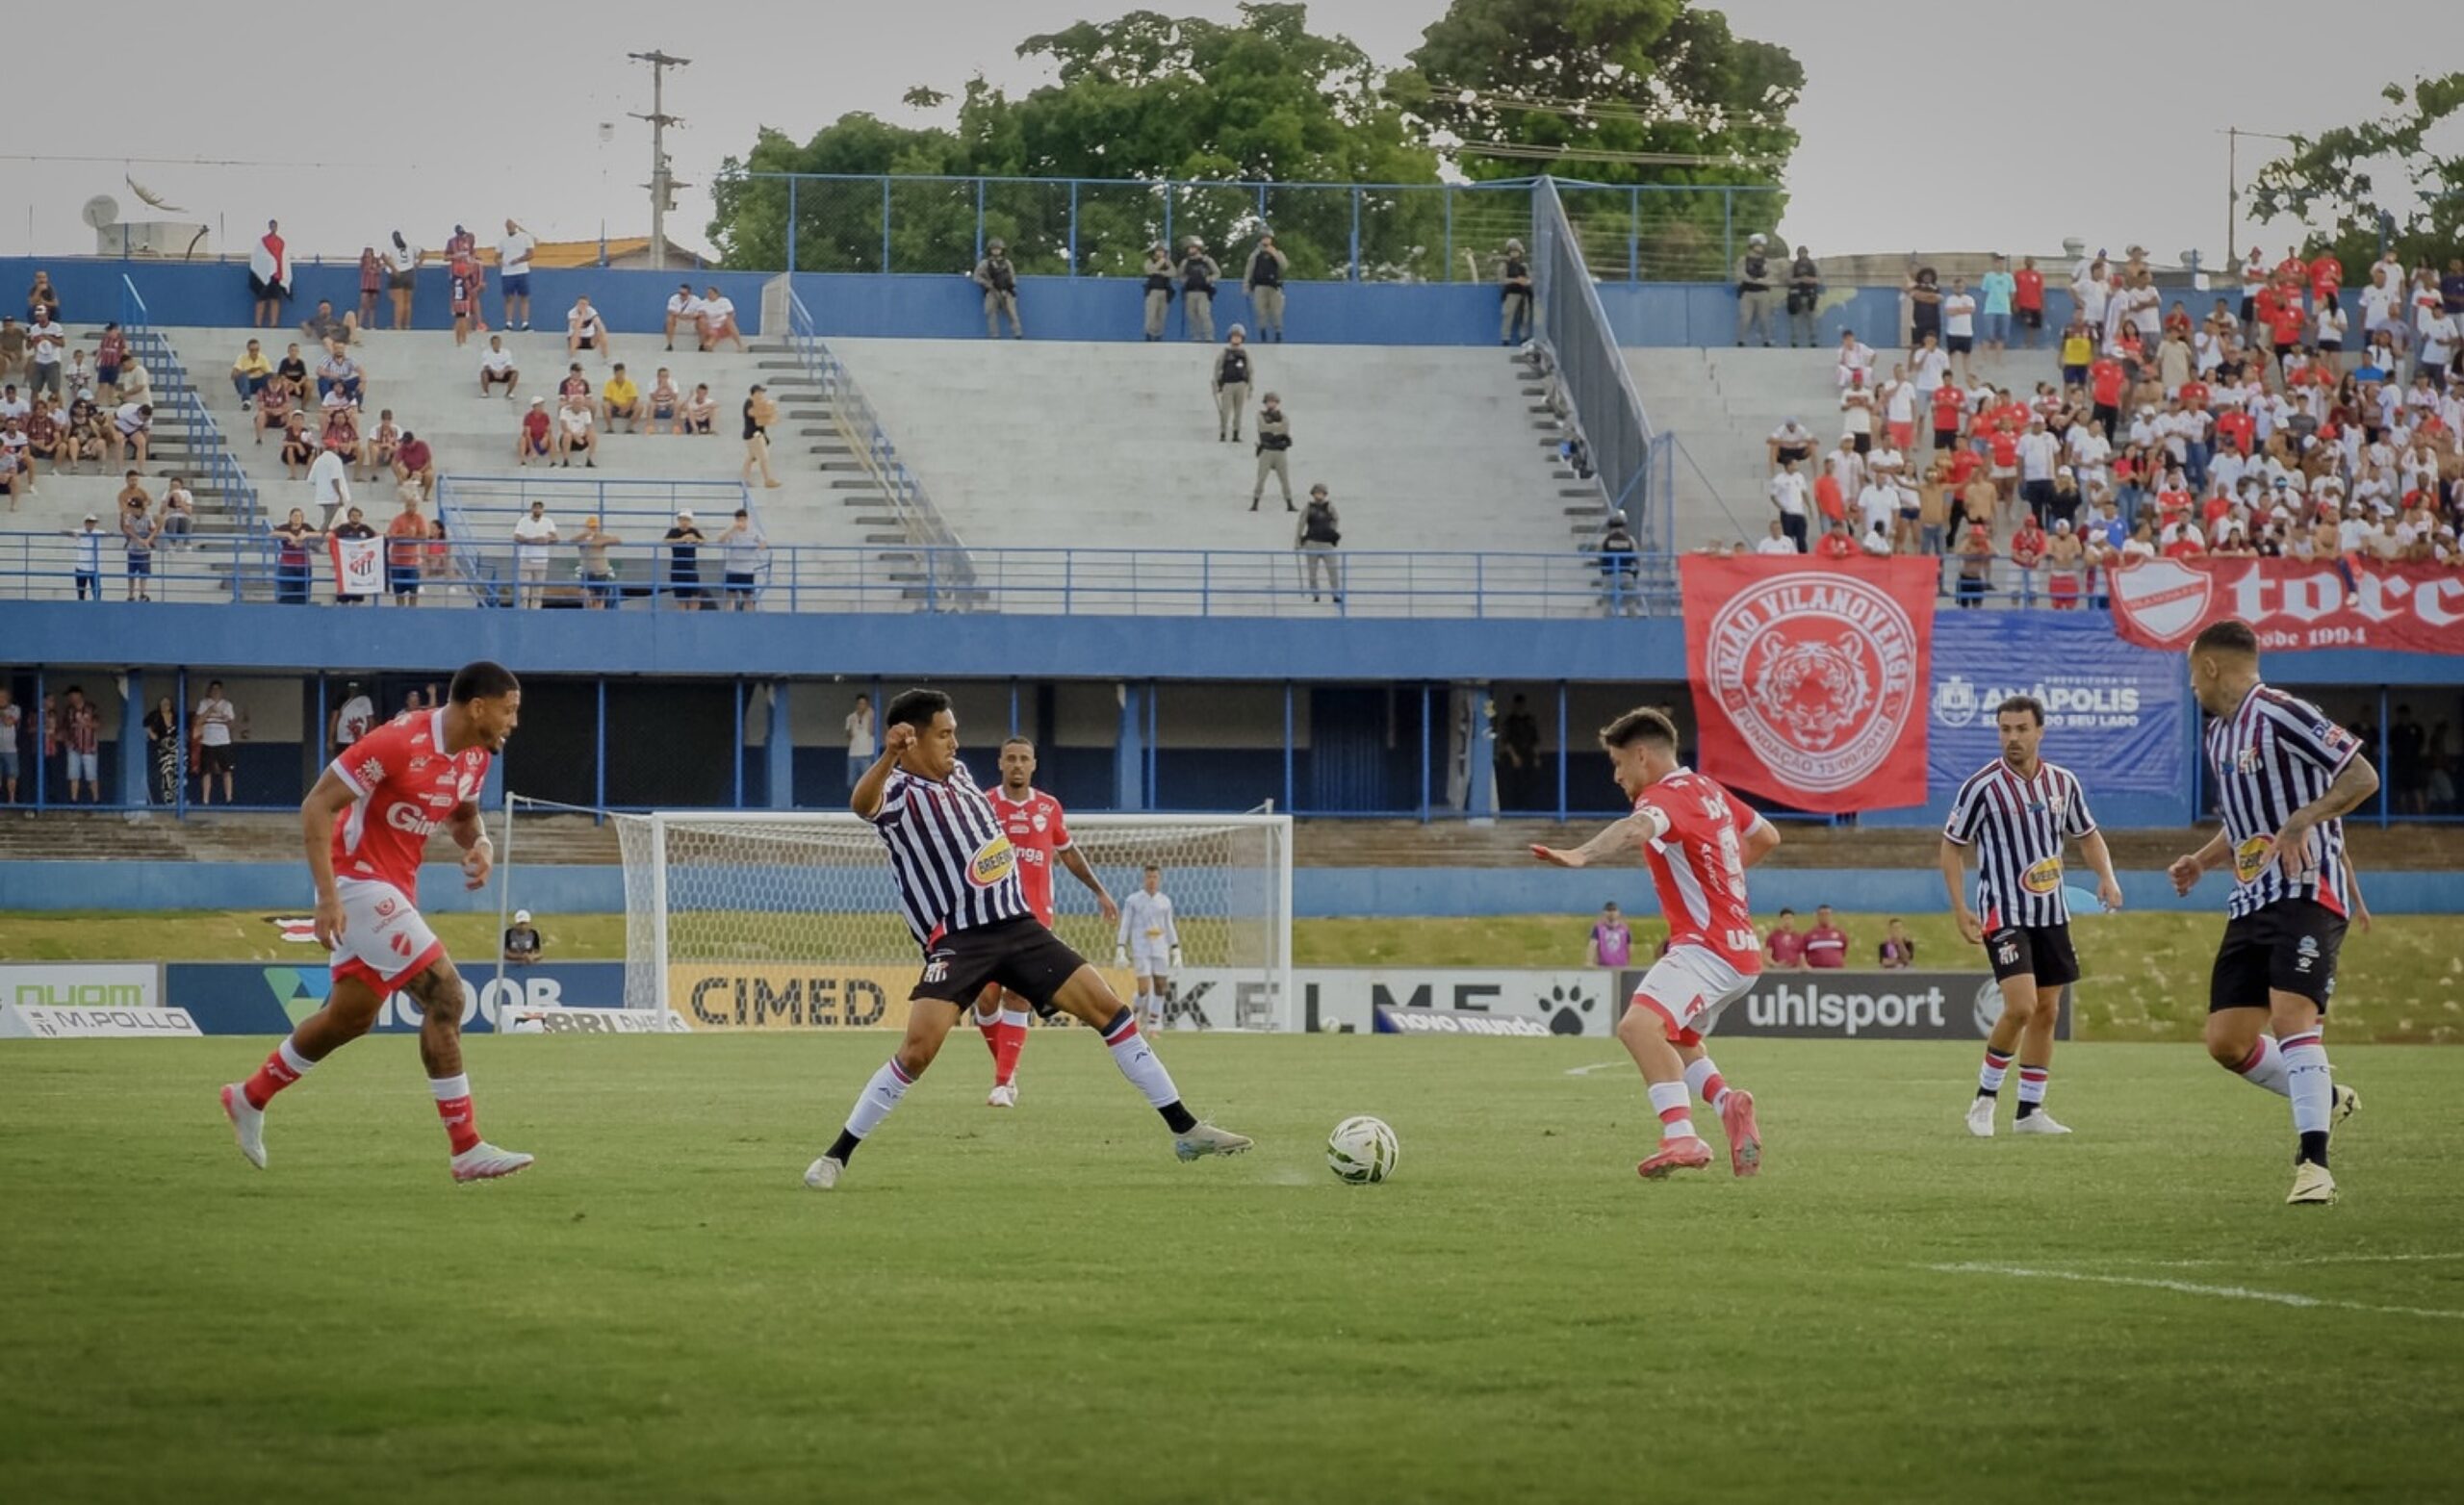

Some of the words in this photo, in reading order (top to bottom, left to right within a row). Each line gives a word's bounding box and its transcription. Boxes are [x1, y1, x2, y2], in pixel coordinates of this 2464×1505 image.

[2100, 715, 2139, 727] LADO
[54, 1011, 192, 1029] M.POLLO
[690, 978, 886, 1026] CIMED
[1164, 981, 1502, 1034] KELME
[1748, 983, 1945, 1035] uhlsport
[1390, 1011, 1460, 1033] novo
[1458, 1015, 1551, 1037] mundo
